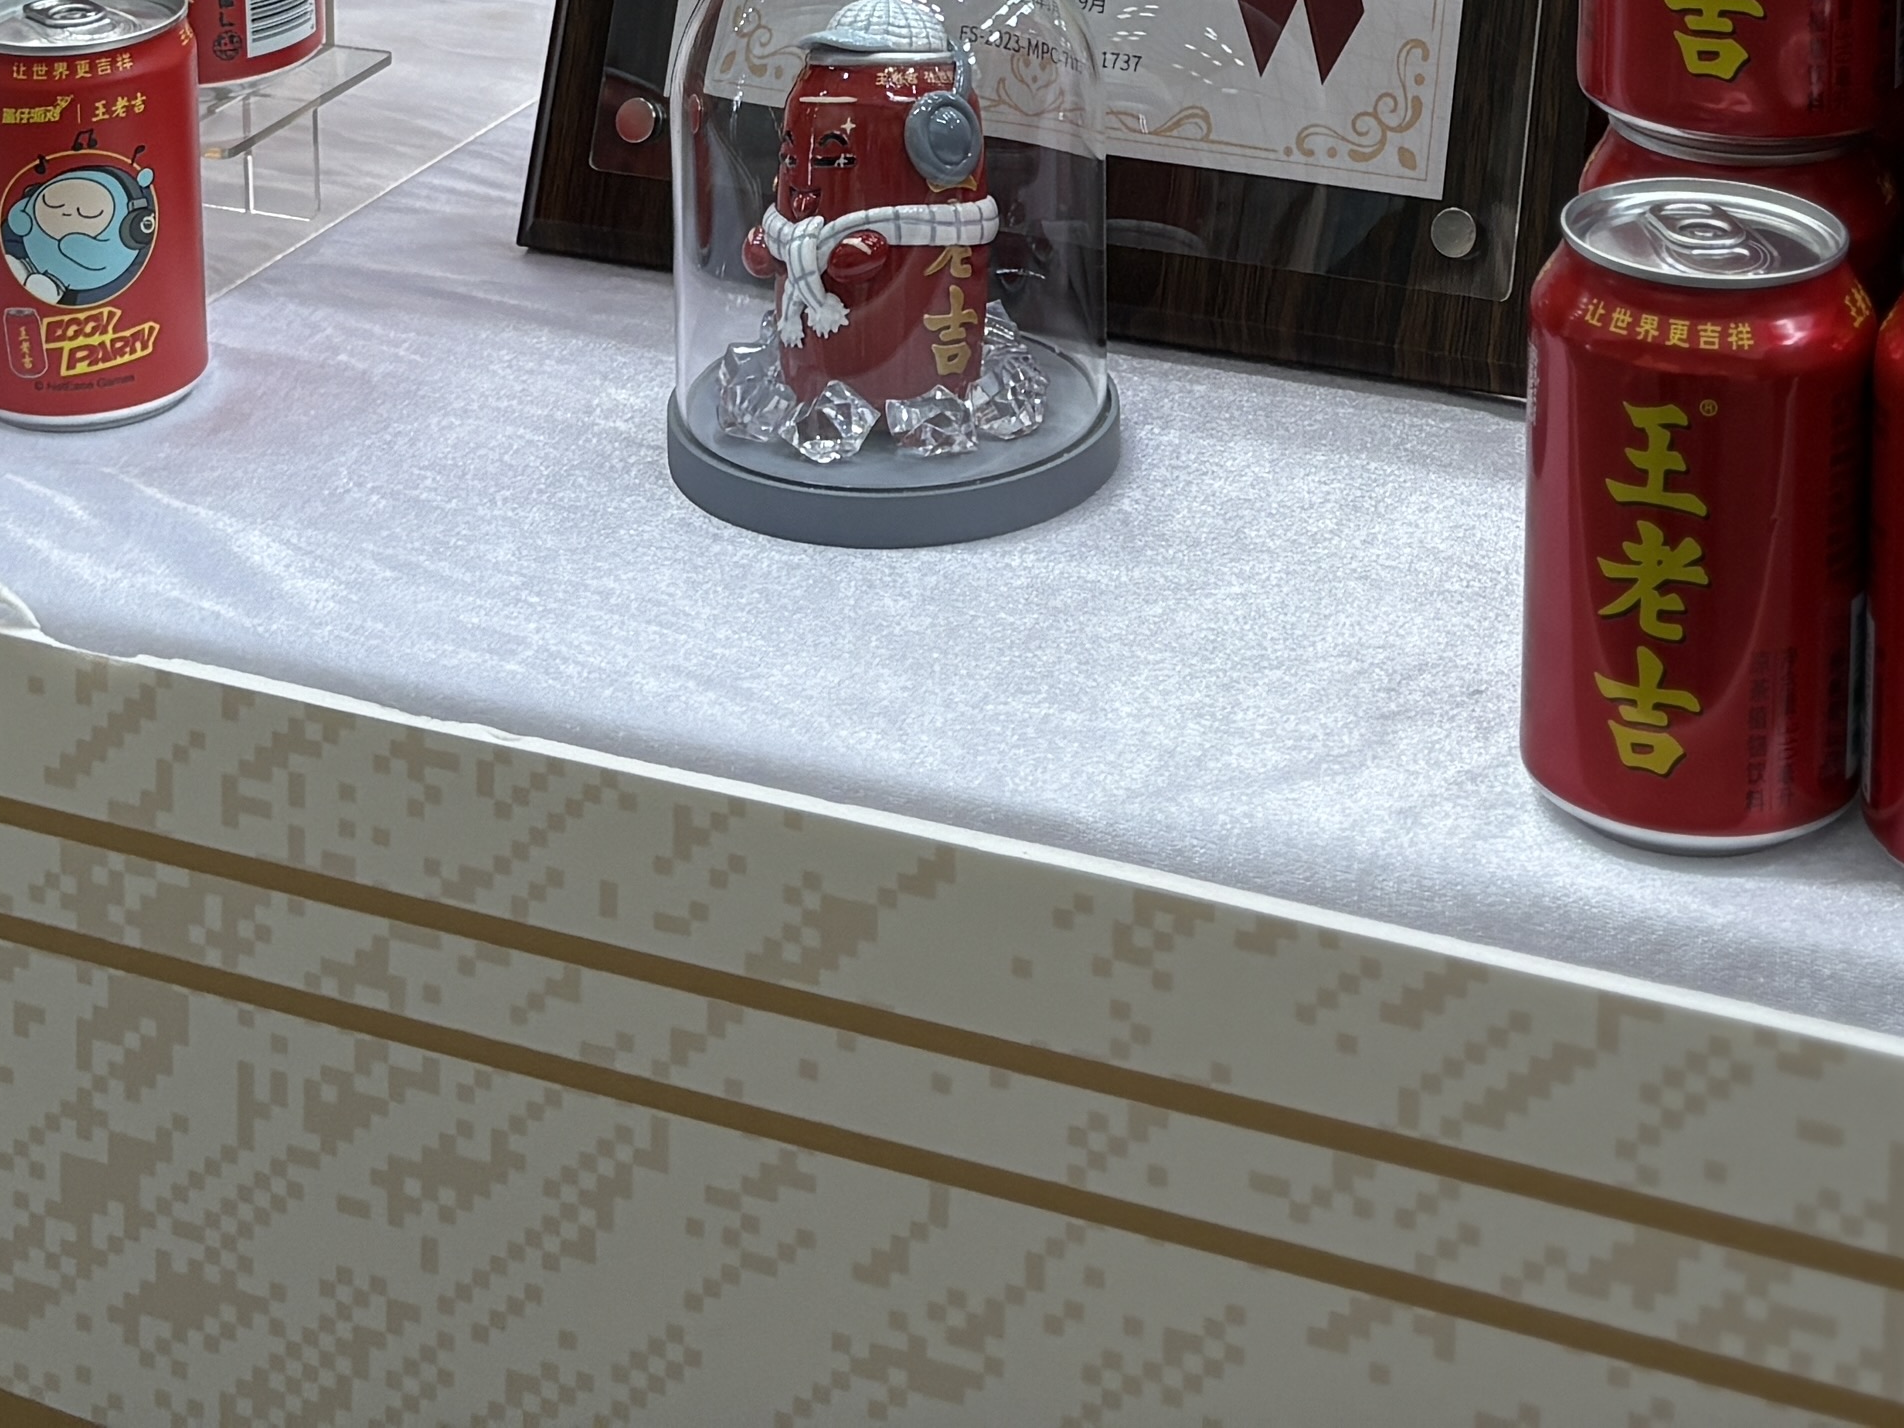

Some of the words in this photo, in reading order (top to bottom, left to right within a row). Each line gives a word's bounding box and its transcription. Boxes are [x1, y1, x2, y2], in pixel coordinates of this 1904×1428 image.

[13, 52, 133, 81] 让世界更吉祥
[91, 92, 148, 123] 王老吉
[1586, 299, 1755, 351] 让世界更吉祥
[17, 327, 34, 371] 王老吉
[65, 325, 157, 373] PARTY
[1594, 401, 1709, 776] 王老吉
